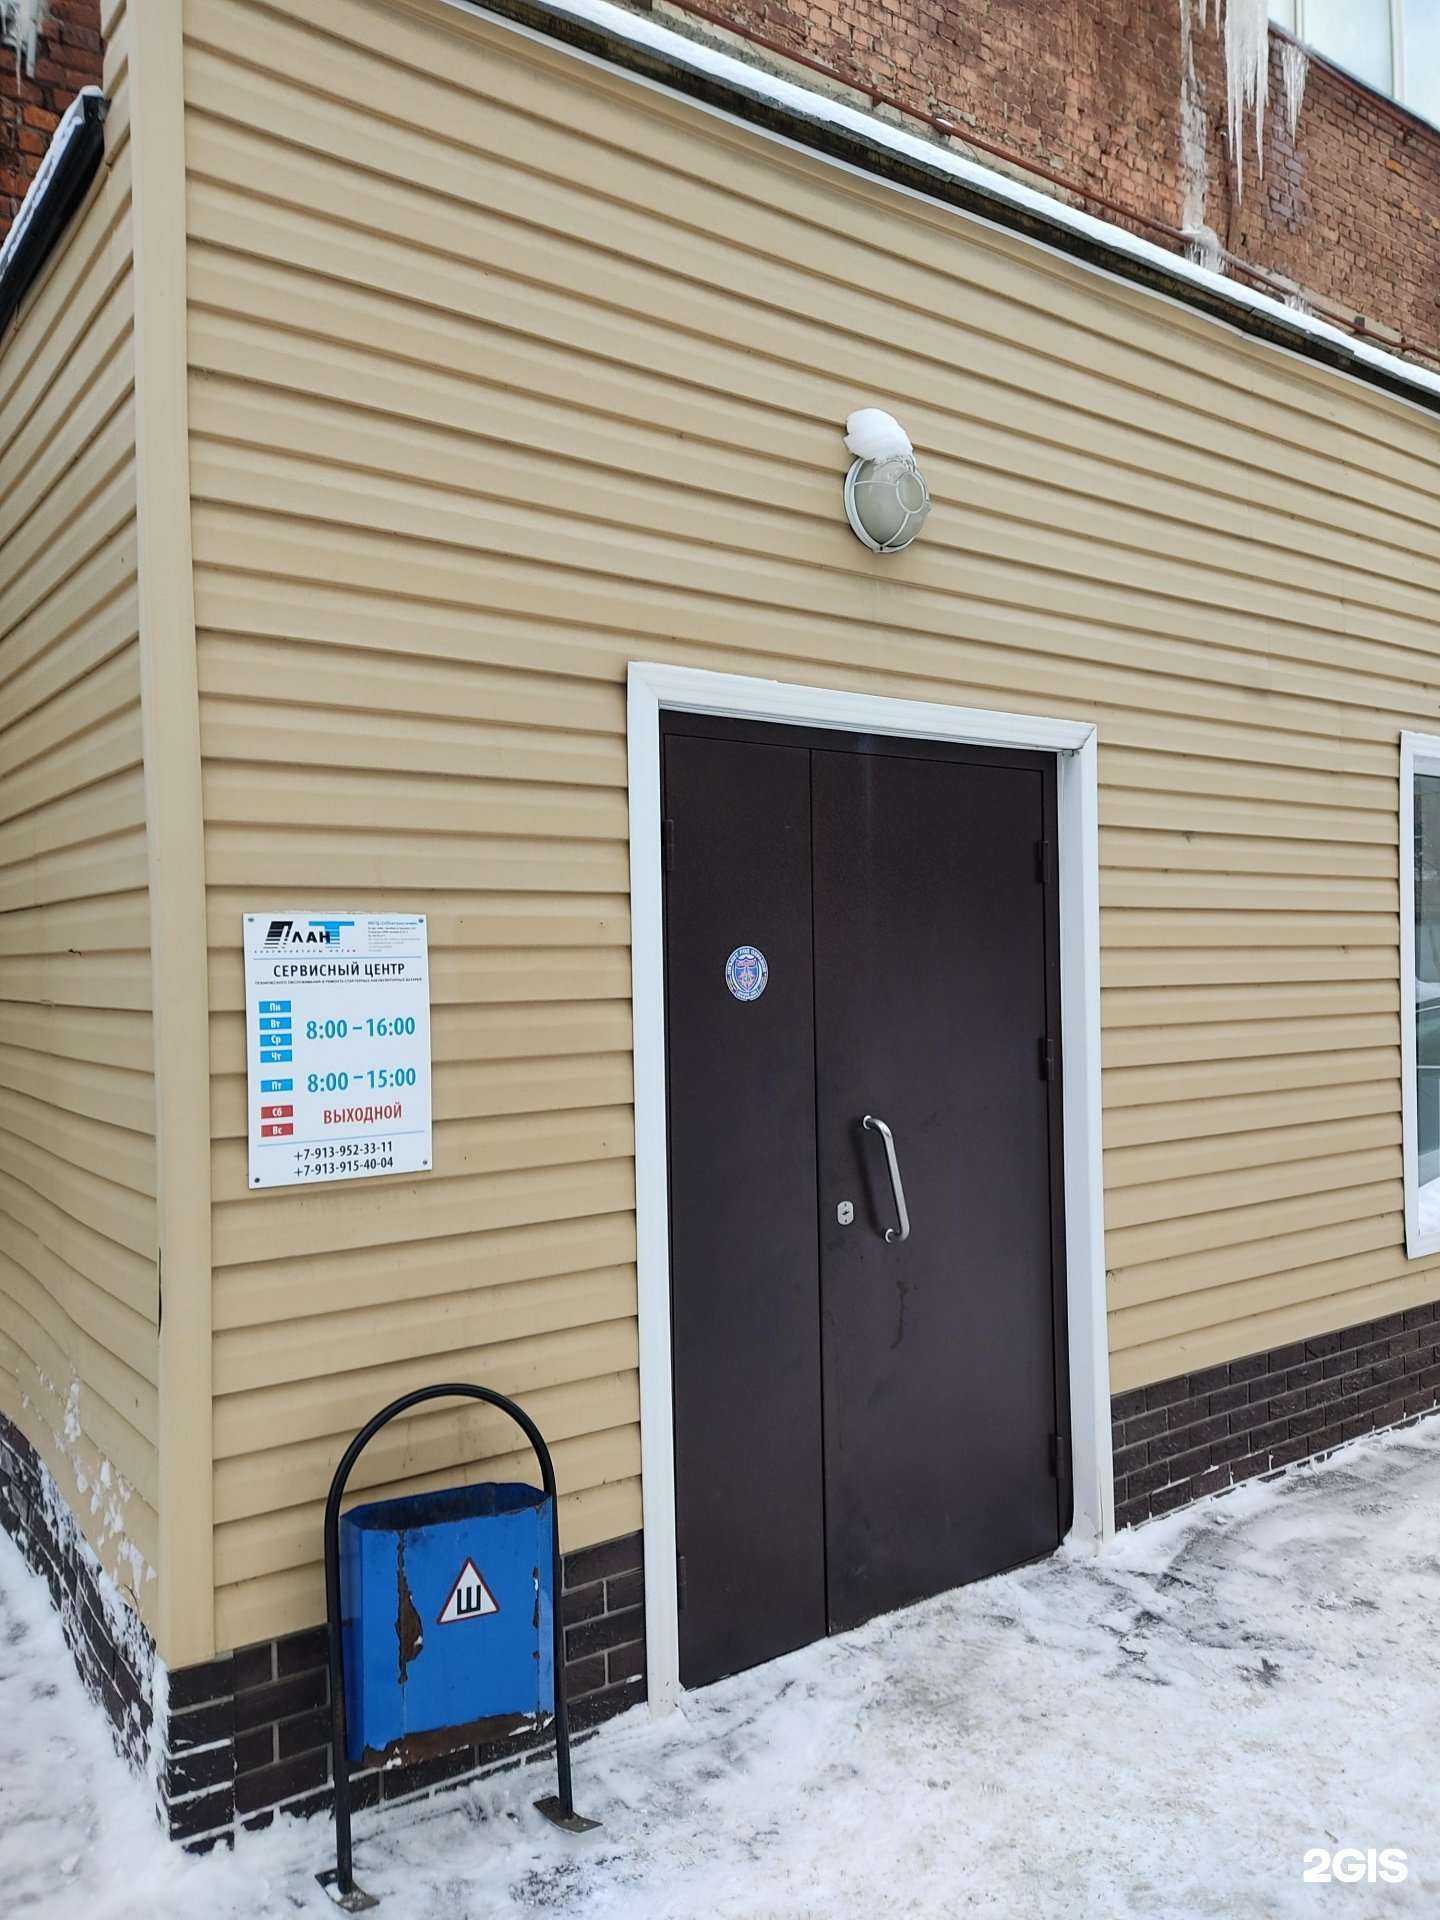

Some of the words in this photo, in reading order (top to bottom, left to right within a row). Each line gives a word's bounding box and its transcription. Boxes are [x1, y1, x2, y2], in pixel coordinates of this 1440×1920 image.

[273, 961, 360, 977] СЕРВИСНЫЙ
[364, 963, 405, 978] ЦЕНТР
[323, 1101, 402, 1125] ВЫХОДНОЙ
[294, 1140, 393, 1161] +7-913-952-33-11
[294, 1156, 394, 1177] +7-913-915-40-04
[457, 1584, 481, 1616] Ш
